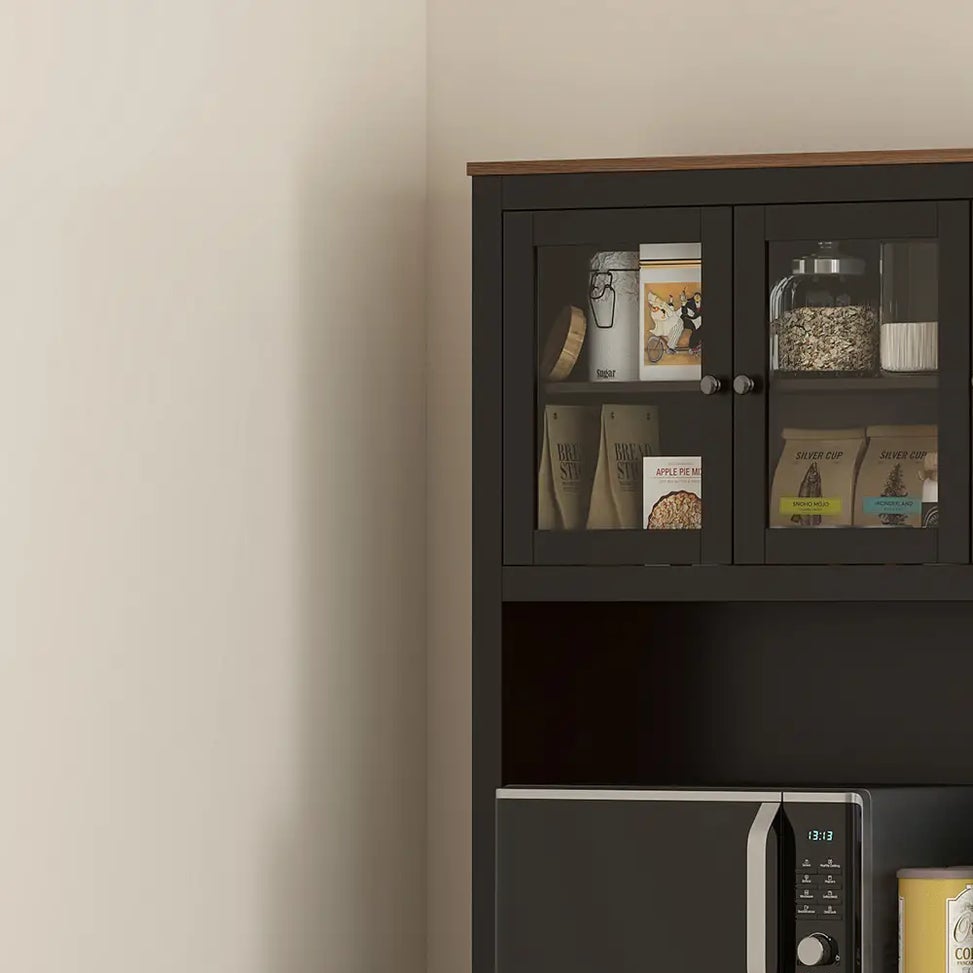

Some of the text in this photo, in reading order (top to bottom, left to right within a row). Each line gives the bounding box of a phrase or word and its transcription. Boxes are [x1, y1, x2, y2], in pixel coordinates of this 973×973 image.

[796, 451, 844, 461] SILVER CUP
[879, 450, 928, 460] SILVER CUP
[655, 467, 678, 477] APPLE
[679, 467, 691, 476] PIE
[808, 830, 833, 841] 13:13
